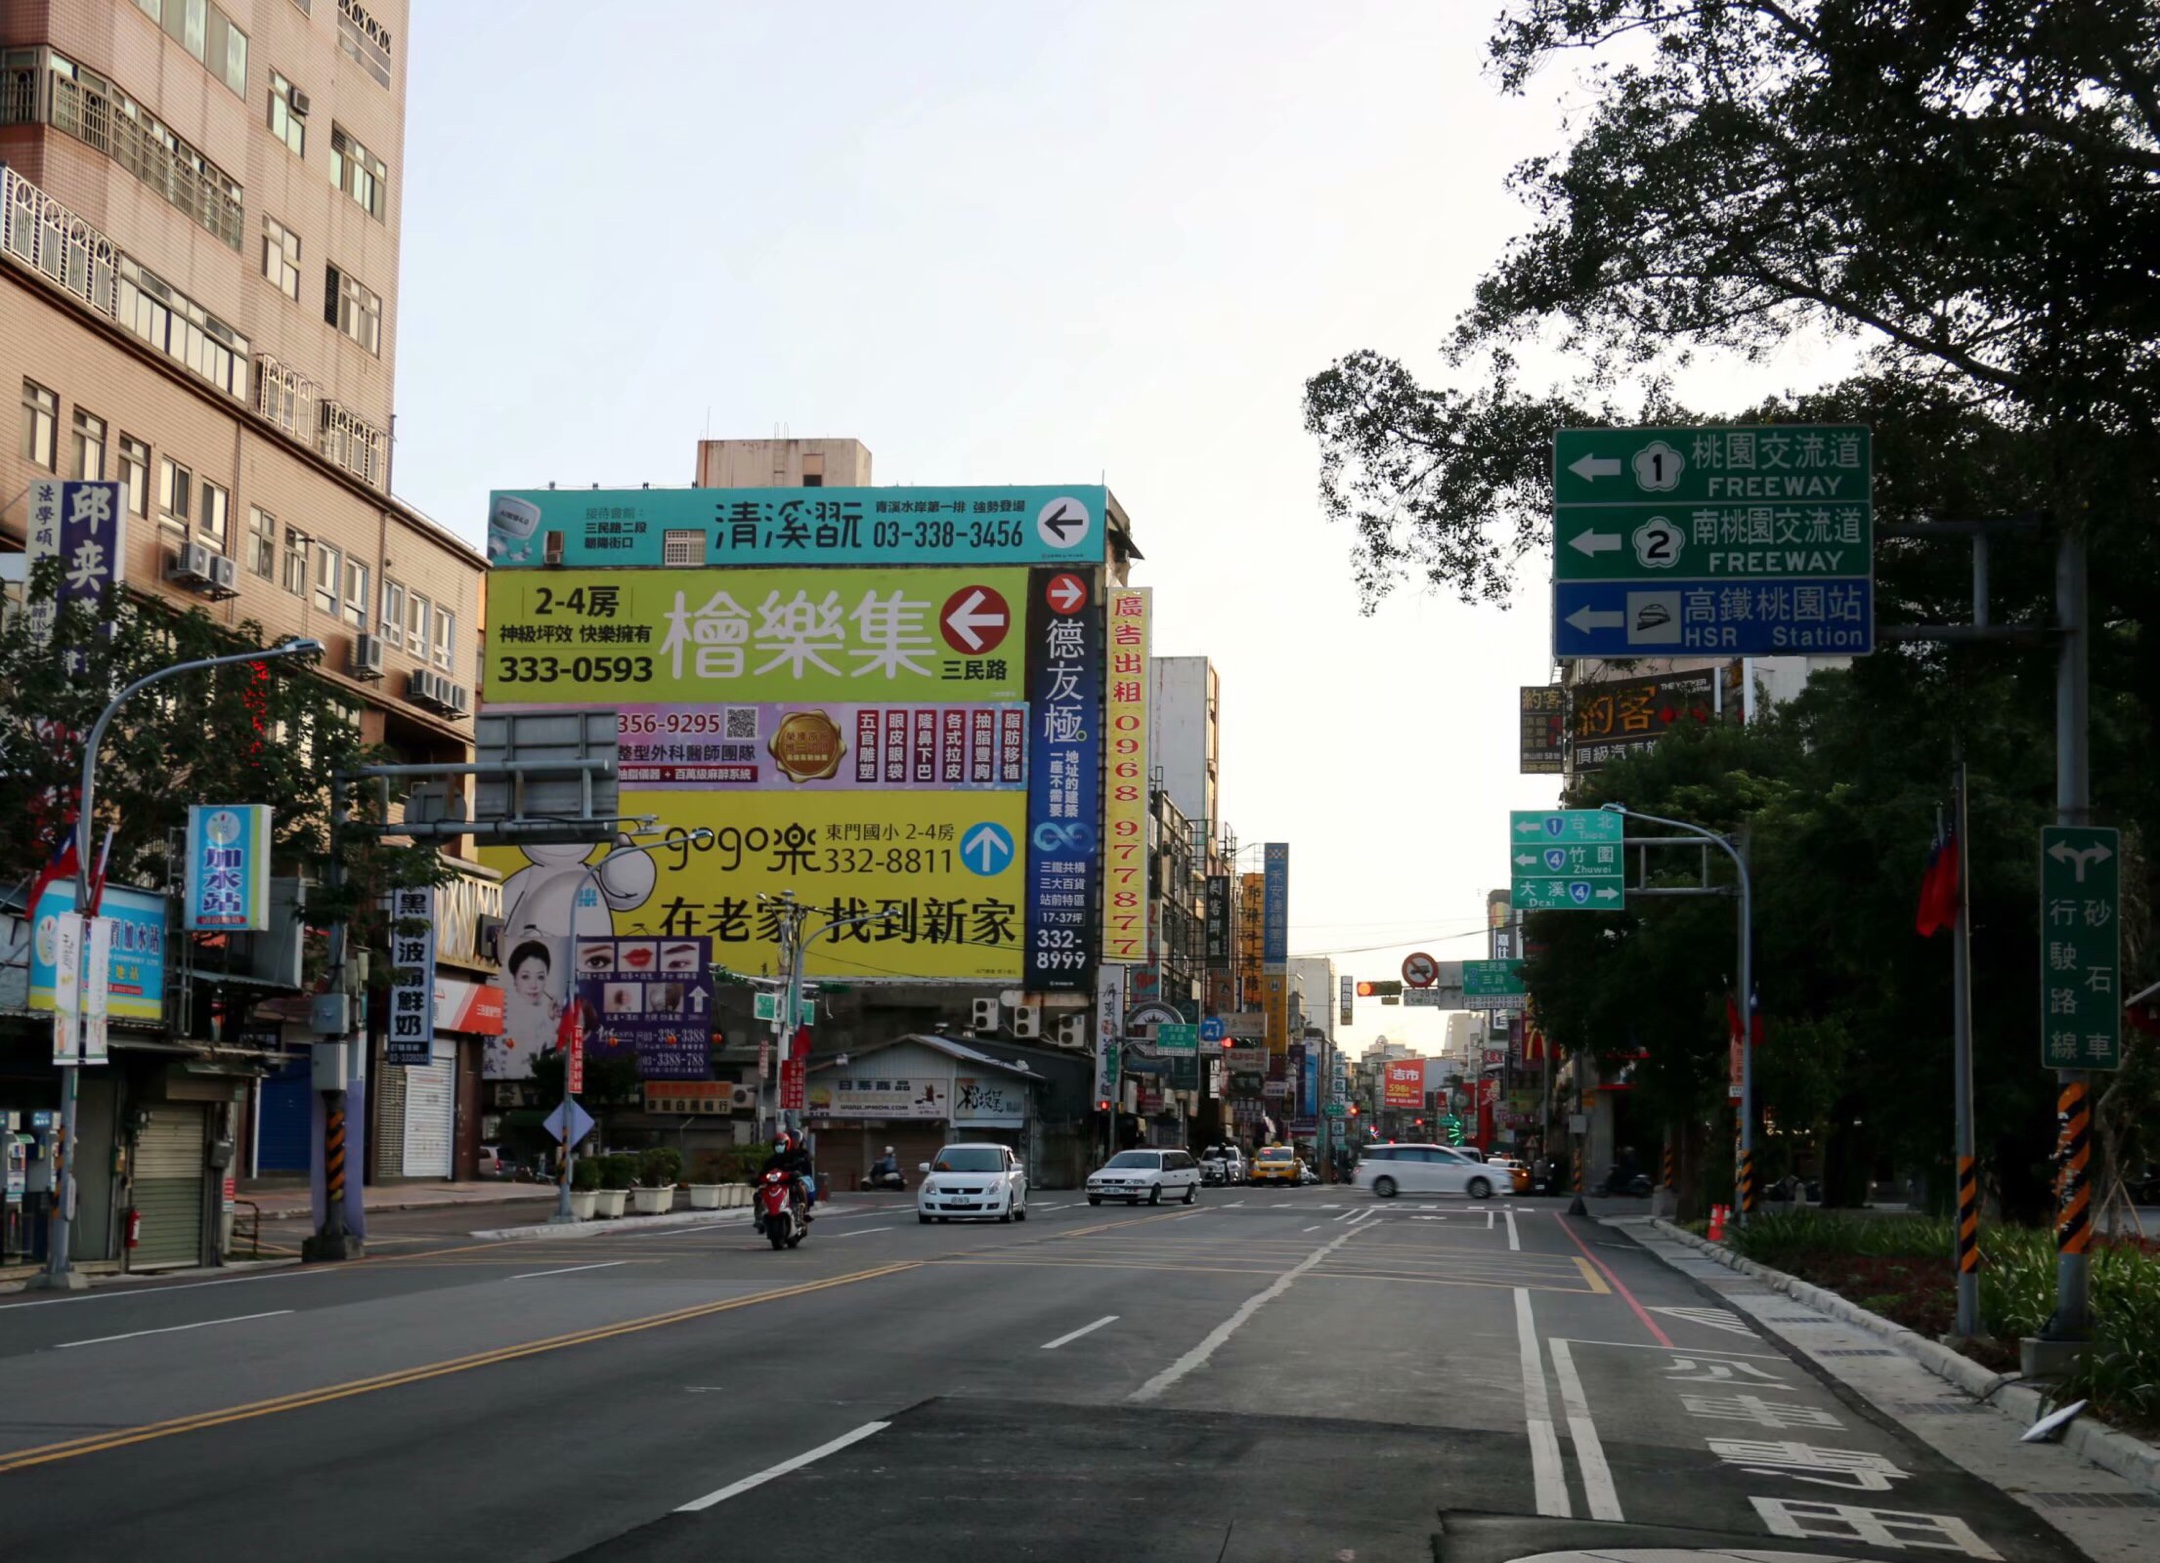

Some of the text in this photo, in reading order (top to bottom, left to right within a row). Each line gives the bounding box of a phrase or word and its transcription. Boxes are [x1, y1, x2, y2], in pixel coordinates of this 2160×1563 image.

[1691, 432, 1861, 470] 桃園交流道
[1652, 453, 1663, 482] 1
[1708, 476, 1843, 497] FREEWAY
[973, 500, 1026, 514] 強勢登場
[584, 522, 647, 534] 三民路二段
[873, 520, 1024, 549] 03-338-3456
[1691, 507, 1862, 545] 南桃園交流道
[1646, 529, 1671, 559] 2
[1708, 551, 1844, 573] FREEWAY
[535, 586, 620, 618] 2-4房
[1684, 585, 1862, 624] 高鐵桃園站
[499, 624, 653, 644] 神級坪效 快樂擁有
[659, 590, 937, 680] 檜樂集
[1684, 625, 1863, 647] HSR Station
[1114, 596, 1143, 703] 廣告出租
[498, 657, 654, 683] 333-0593
[941, 659, 1008, 681] 三民路
[1522, 688, 1563, 711] 約客
[1574, 686, 1657, 737] 約客
[617, 745, 756, 762] 整型外科醫師團隊
[858, 713, 877, 780] 五官雕塑
[887, 713, 905, 780] 眼皮眼袋
[917, 713, 934, 780] 隆鼻下巴
[945, 713, 963, 780] 各式拉皮
[974, 713, 992, 780] 抽脂豐胸
[1003, 713, 1022, 780] 脂肪移植
[1049, 752, 1064, 818] 一座不需要
[1064, 750, 1079, 819] 地址的建築
[826, 823, 955, 842] 東門國小 2-4房
[1112, 715, 1141, 955] 0968 977877
[824, 848, 952, 874] 332-8811
[1549, 852, 1560, 866] 4
[1573, 864, 1612, 874] Zhuwei
[203, 847, 243, 913] 加水站
[1040, 877, 1086, 890] 三大百貨
[1519, 880, 1566, 898] 大溪
[1574, 885, 1585, 898] 4
[1040, 893, 1086, 906] 站前特區
[825, 897, 1017, 945] 找到新家
[1042, 911, 1083, 924] 17-37坪
[1037, 929, 1082, 949] 332-
[1036, 951, 1086, 969] 8999
[2049, 898, 2078, 1060] 行駛路線
[2083, 898, 2113, 1061] 砂石車
[838, 1080, 911, 1091] 日系商品
